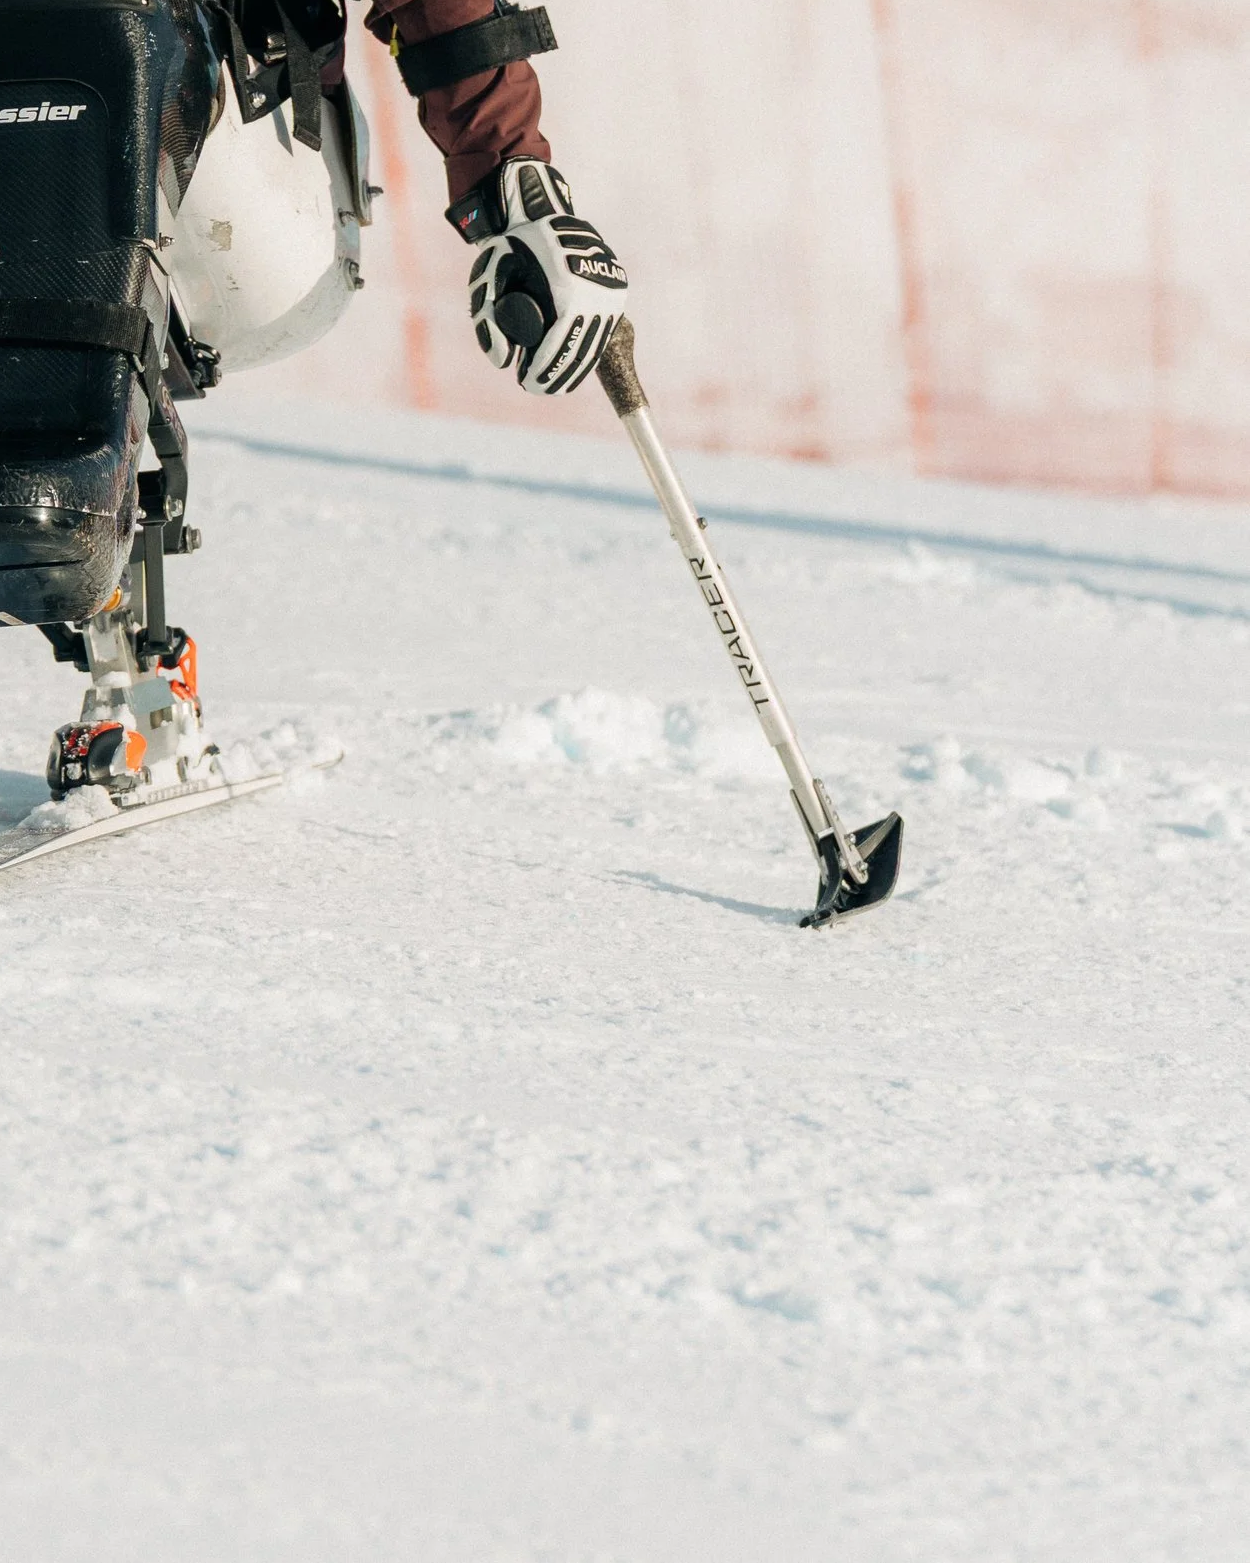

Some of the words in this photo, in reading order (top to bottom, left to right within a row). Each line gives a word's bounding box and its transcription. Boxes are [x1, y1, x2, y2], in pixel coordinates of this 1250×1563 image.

[579, 259, 627, 282] AUCLAIR
[547, 325, 582, 379] AUCLAIR
[688, 556, 770, 714] TRACER
